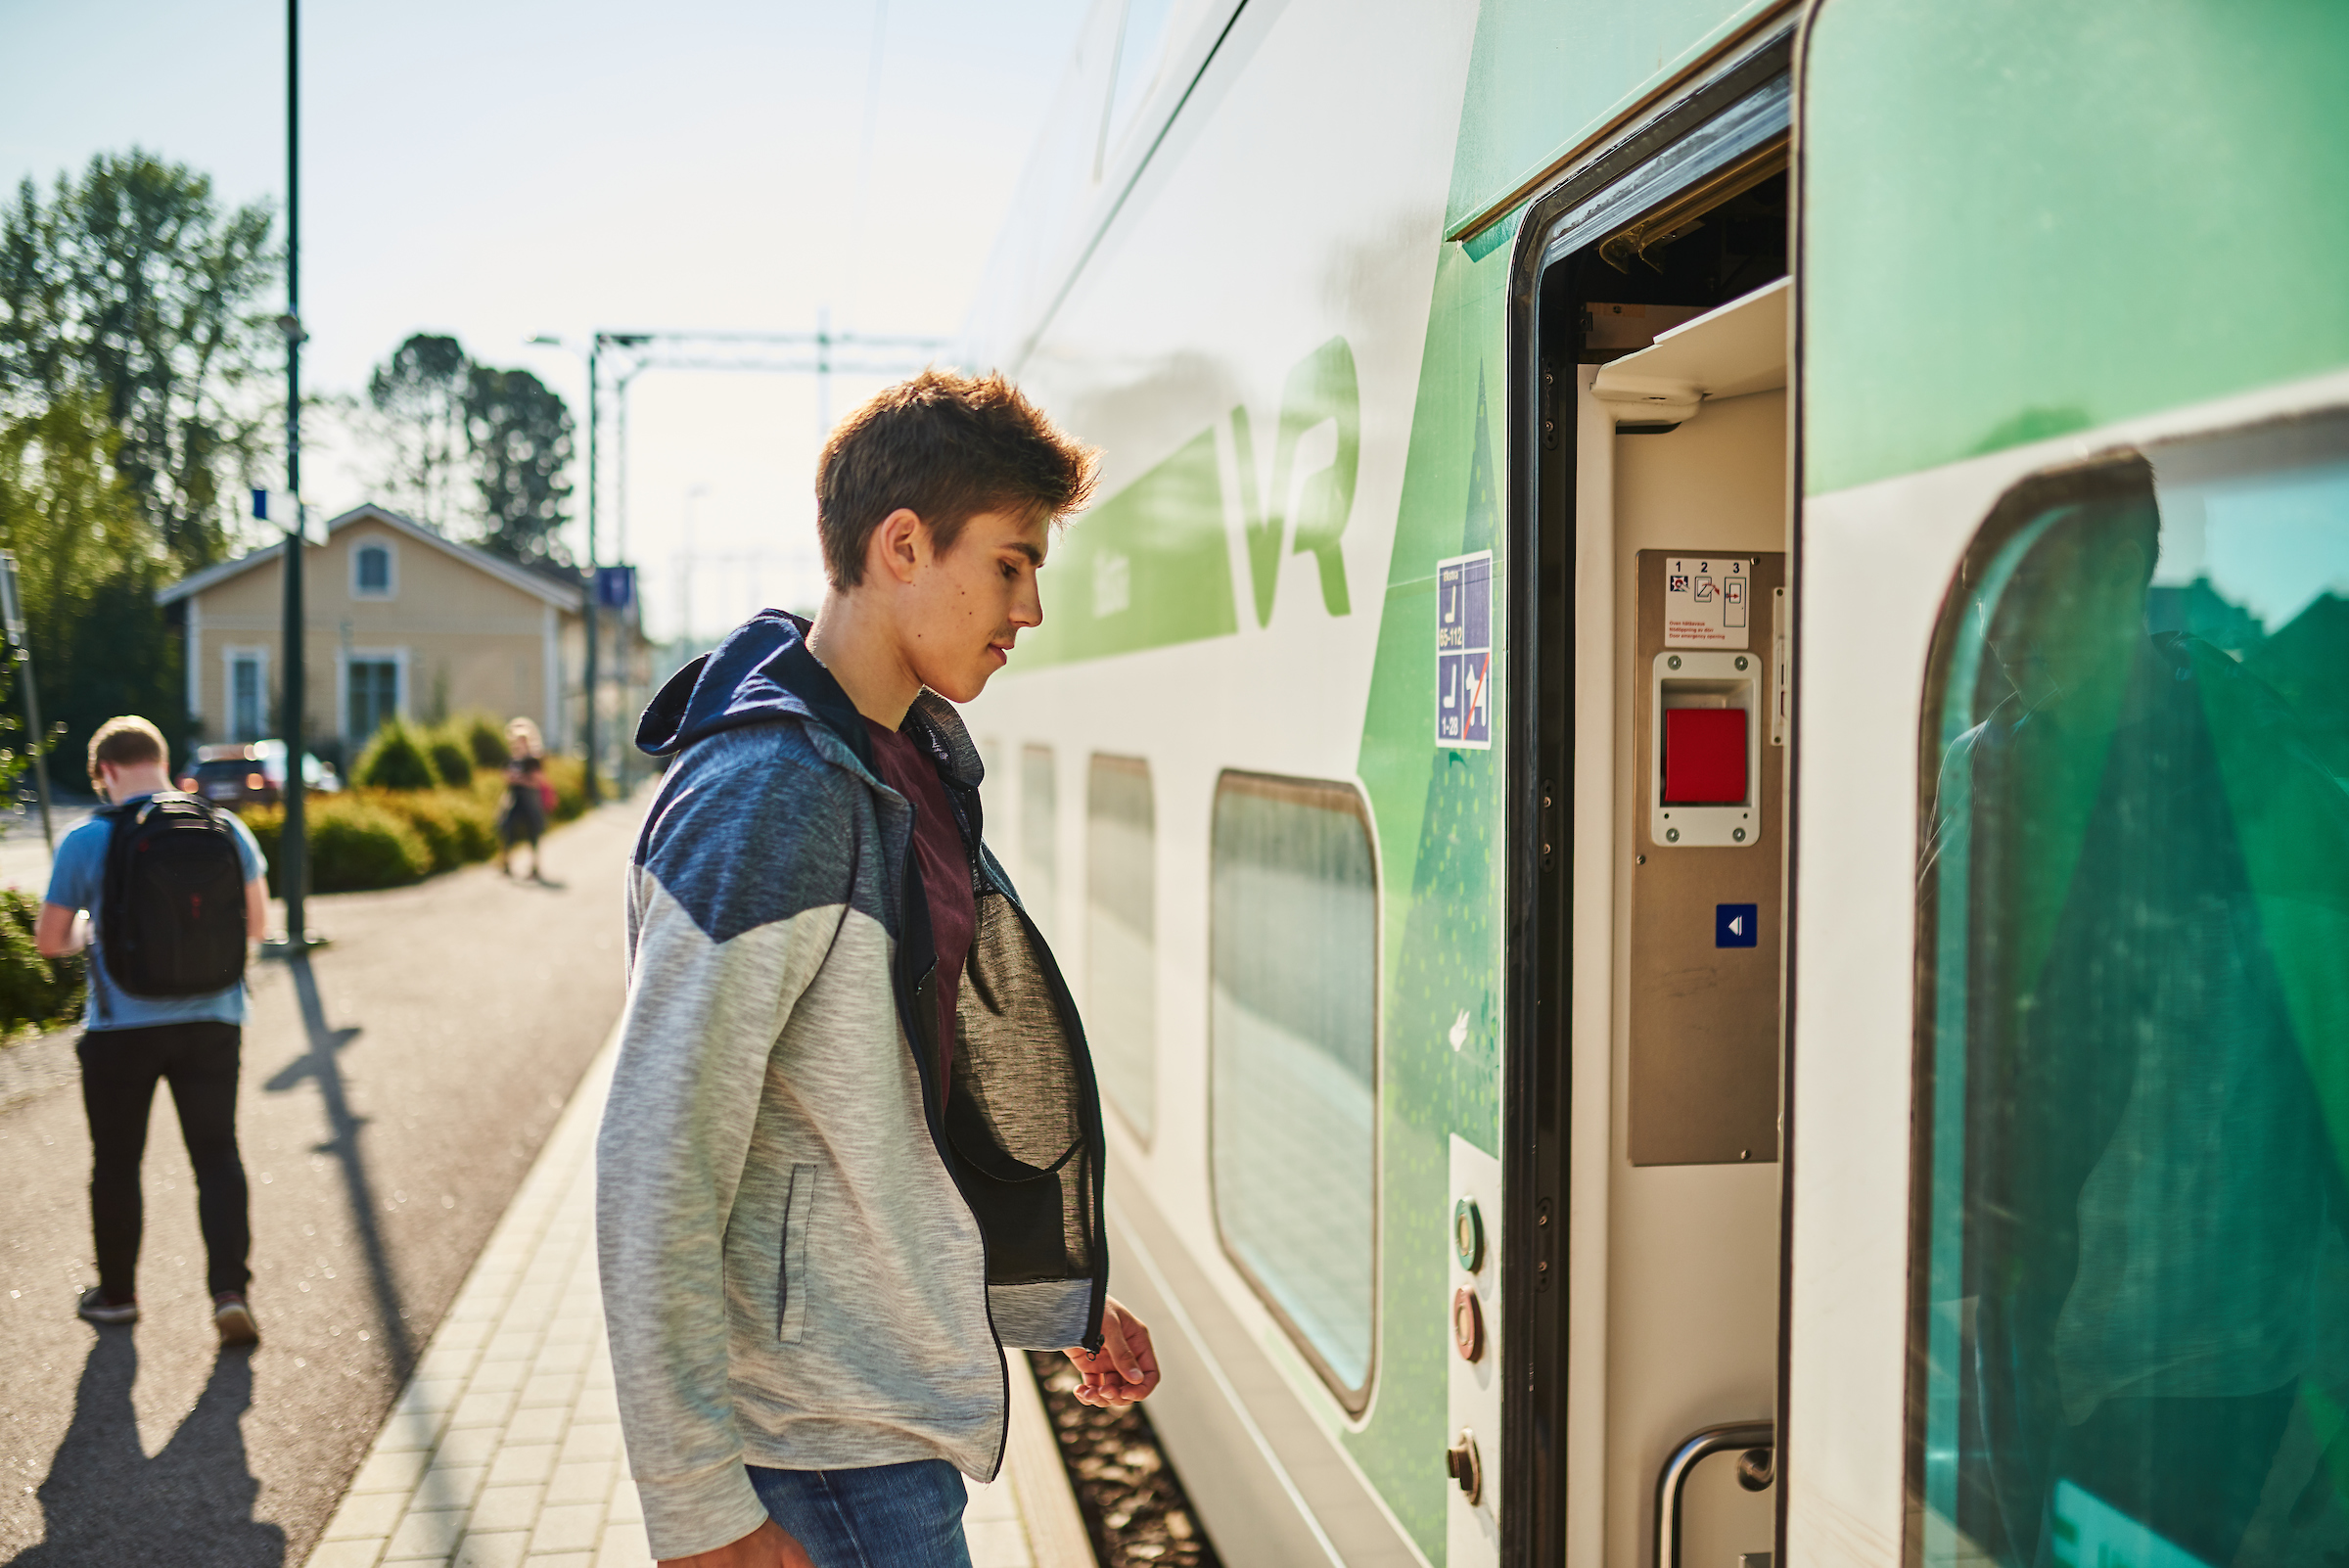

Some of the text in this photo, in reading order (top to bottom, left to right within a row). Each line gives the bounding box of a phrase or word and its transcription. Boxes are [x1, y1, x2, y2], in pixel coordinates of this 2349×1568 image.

[1230, 334, 1360, 629] VR
[1676, 561, 1740, 574] 1 2 3
[1440, 625, 1461, 647] 65-112
[1442, 715, 1458, 736] 1-28
